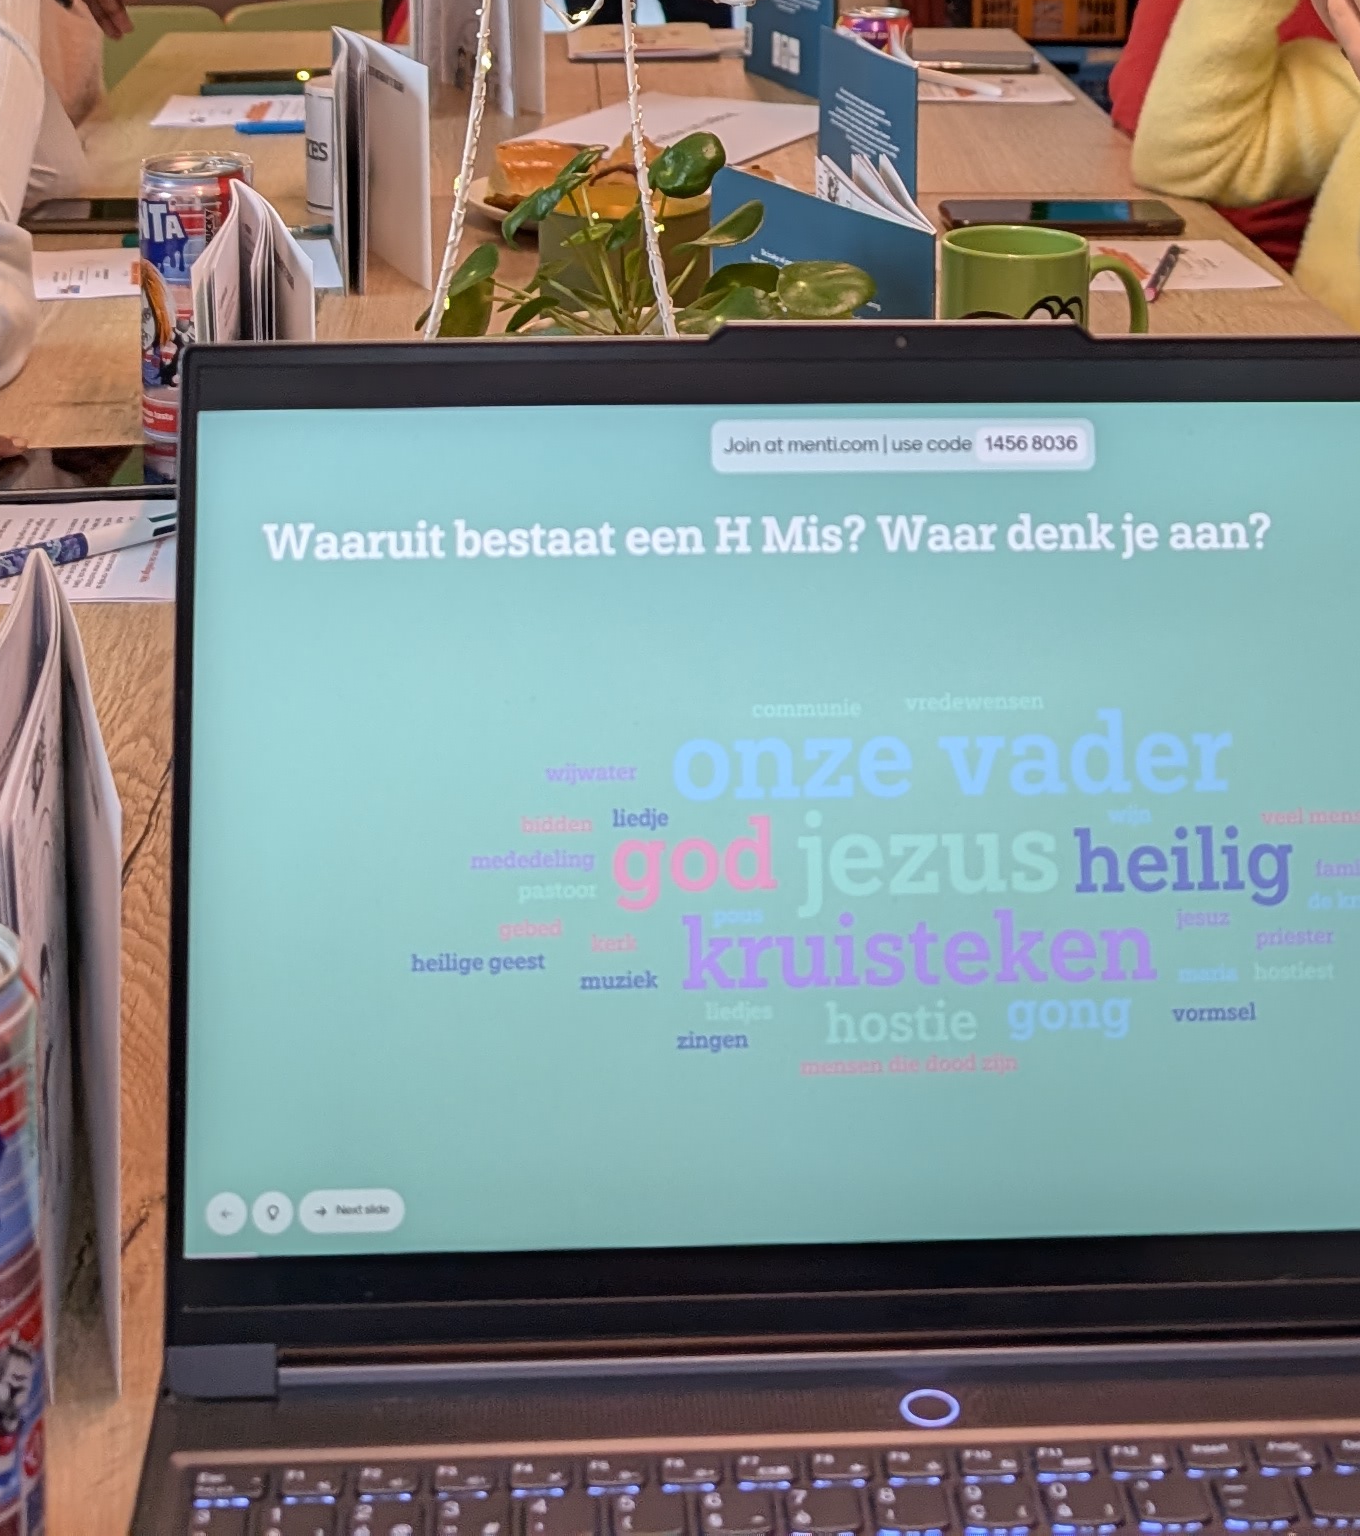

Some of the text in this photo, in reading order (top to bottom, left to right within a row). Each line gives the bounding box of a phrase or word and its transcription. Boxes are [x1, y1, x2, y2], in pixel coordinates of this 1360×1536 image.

[724, 434, 1078, 454] Join at menti.com use code 1456 8036
[262, 512, 1271, 561] Waaruit bestaat een H Mis? Waar denk je aan?
[752, 699, 862, 718] communie
[905, 693, 1044, 712] vredewensen
[673, 708, 1233, 801] onze vader
[546, 764, 638, 785] wijwater
[612, 808, 668, 831] liedje
[470, 849, 596, 872] mededeling
[612, 815, 778, 911] god
[798, 810, 1059, 918] jezus
[1074, 825, 1293, 906] heilig
[518, 883, 598, 904] pastoor
[682, 909, 1158, 990] kruisteken
[1256, 927, 1335, 950] priester
[411, 953, 546, 975] heilige geest
[580, 970, 658, 991] muziek
[825, 1000, 978, 1045] hostie
[1007, 997, 1133, 1041] gong
[1172, 1002, 1257, 1022] vormsel
[676, 1031, 749, 1053] zingen
